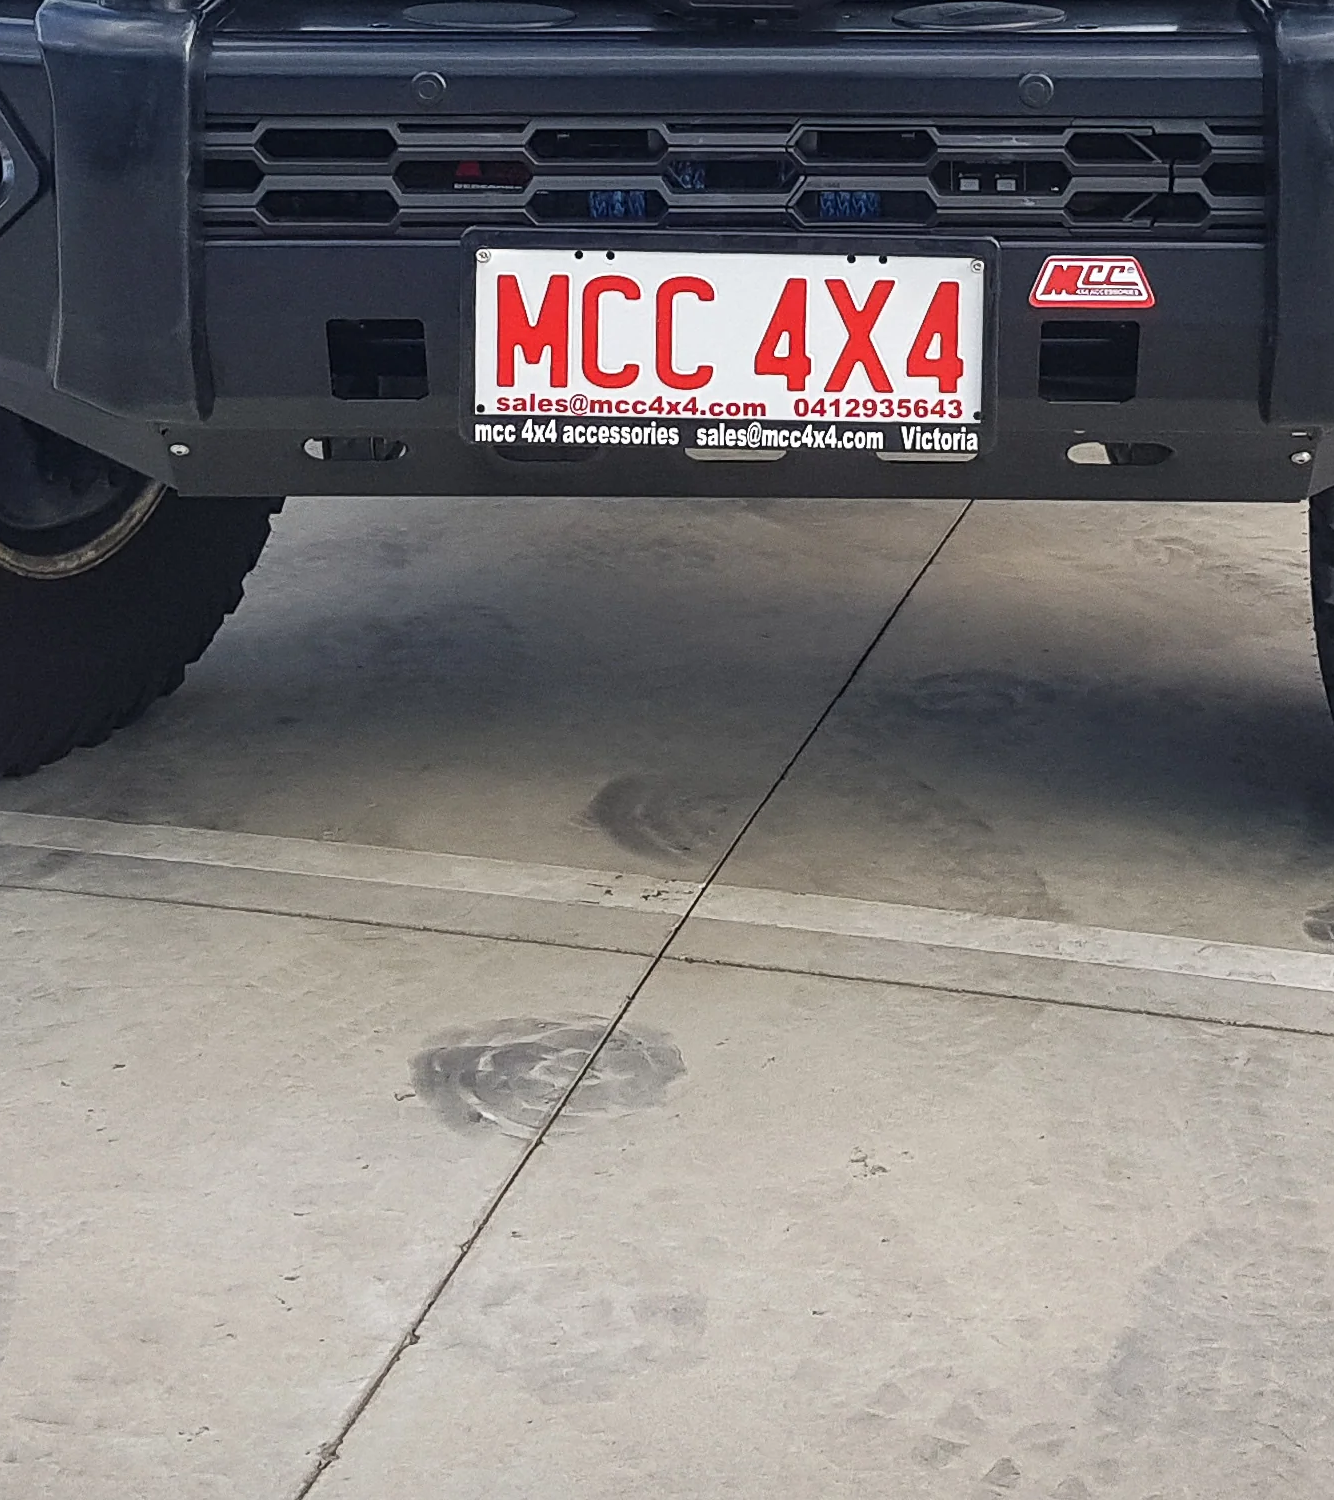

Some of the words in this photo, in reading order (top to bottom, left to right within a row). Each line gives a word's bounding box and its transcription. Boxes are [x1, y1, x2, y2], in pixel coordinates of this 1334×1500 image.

[1040, 264, 1138, 295] MCC
[496, 274, 715, 390] MCC
[754, 278, 964, 393] 4X4
[496, 393, 767, 417] sales@mcc4x4.com
[794, 397, 963, 418] 0412935643
[474, 422, 517, 443] mcc
[521, 418, 558, 442] 4x4
[562, 421, 680, 445] accessories
[696, 421, 884, 449] sales@mcc4x4.com
[901, 425, 979, 451] Victoria
